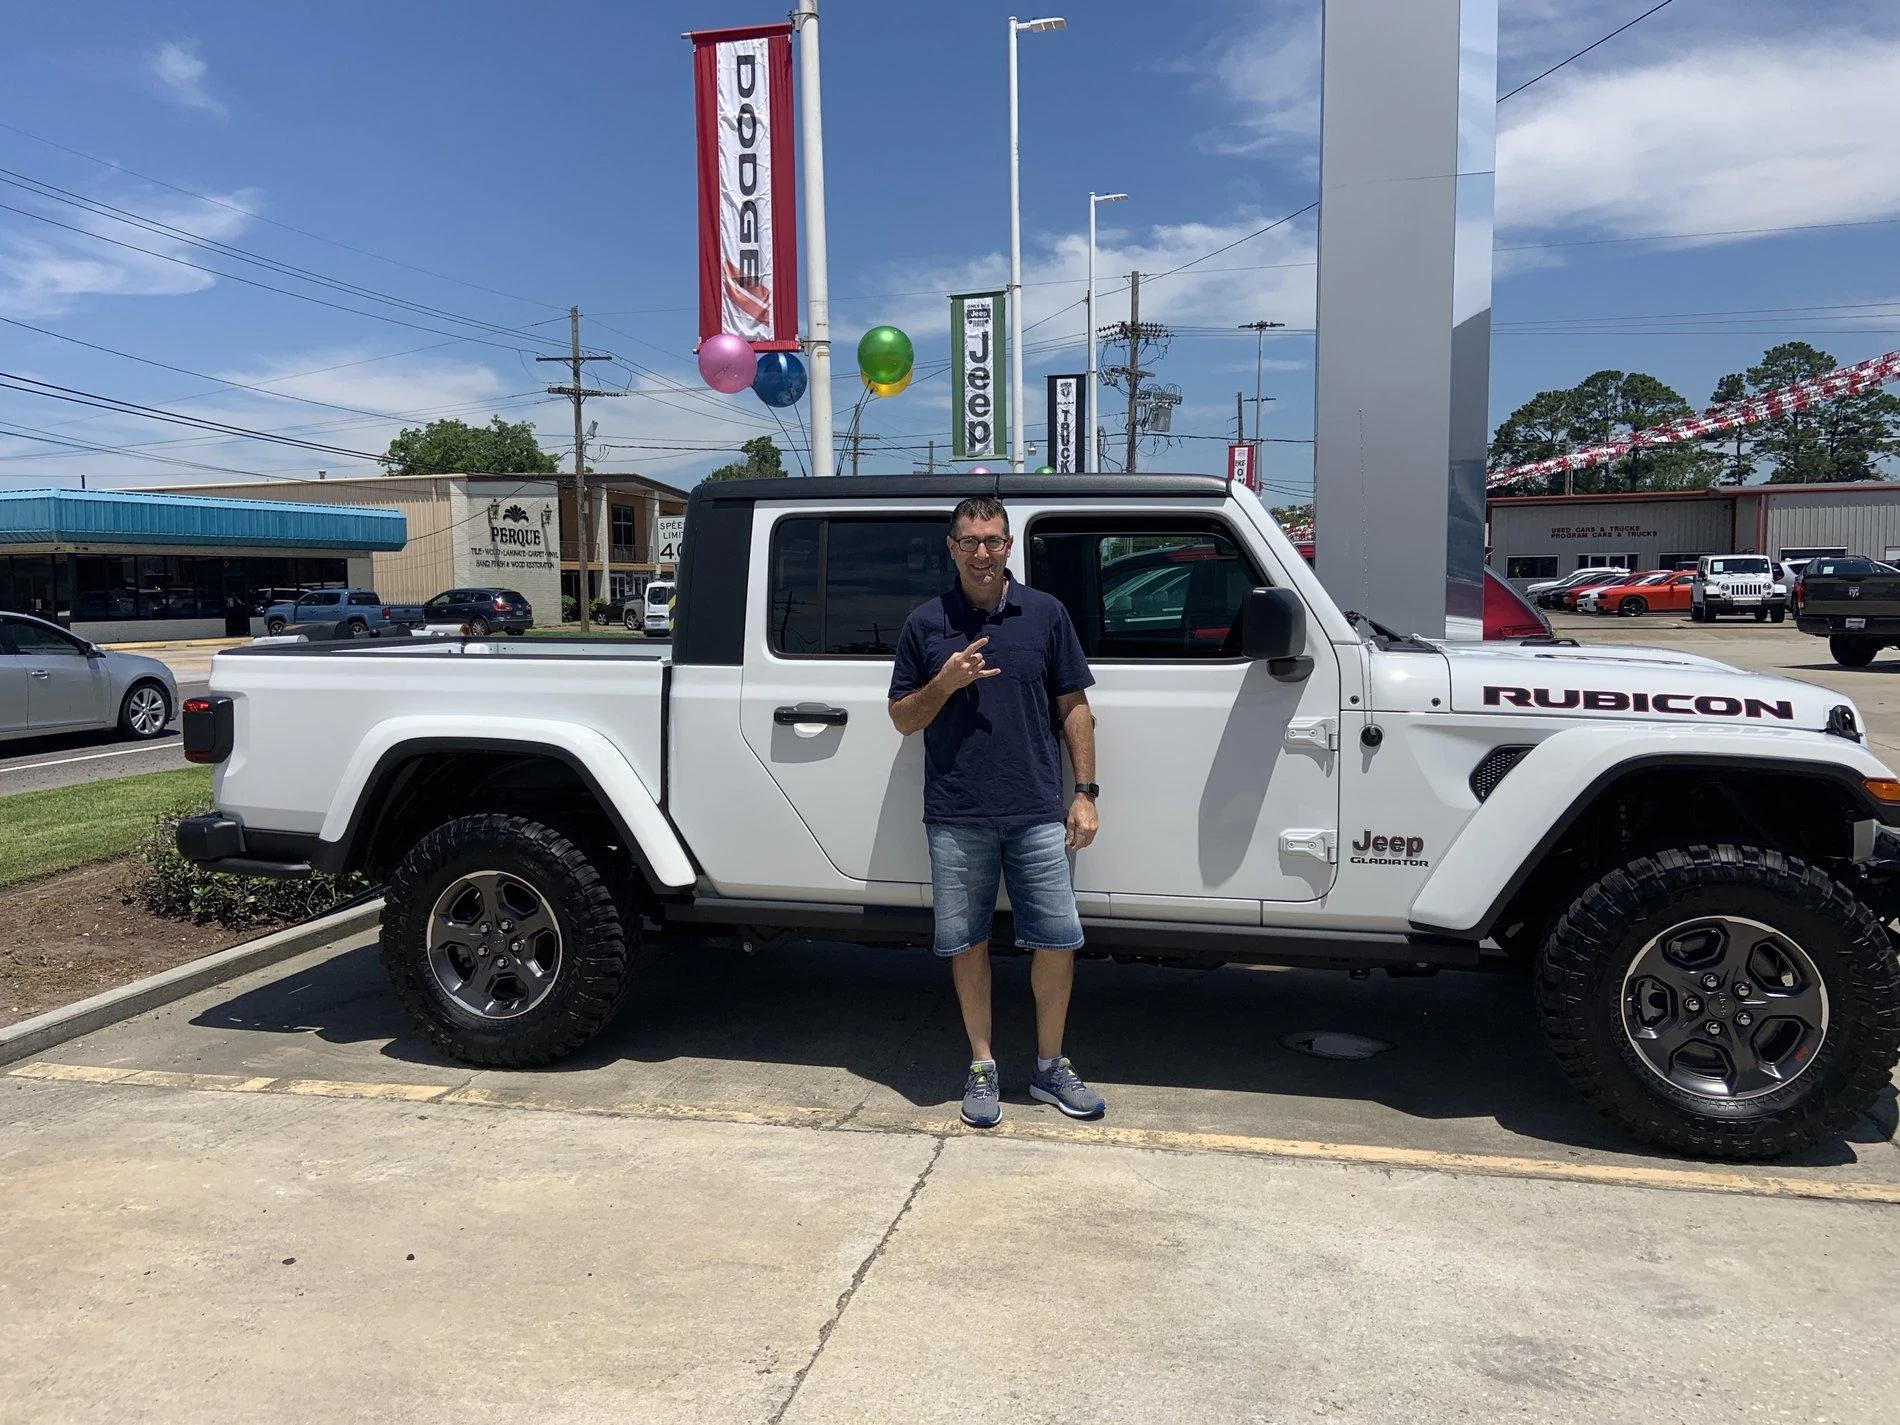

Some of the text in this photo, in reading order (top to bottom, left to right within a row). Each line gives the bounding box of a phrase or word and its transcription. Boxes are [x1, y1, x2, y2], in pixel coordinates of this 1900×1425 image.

[736, 54, 760, 288] DODGE
[970, 310, 988, 318] Jeep
[966, 331, 991, 453] Jeep
[490, 526, 541, 547] PERQUE
[660, 521, 683, 530] SPEE
[1483, 686, 1794, 720] RUBICON
[1352, 828, 1424, 857] Jeep
[1350, 857, 1429, 867] GLADIATOR
